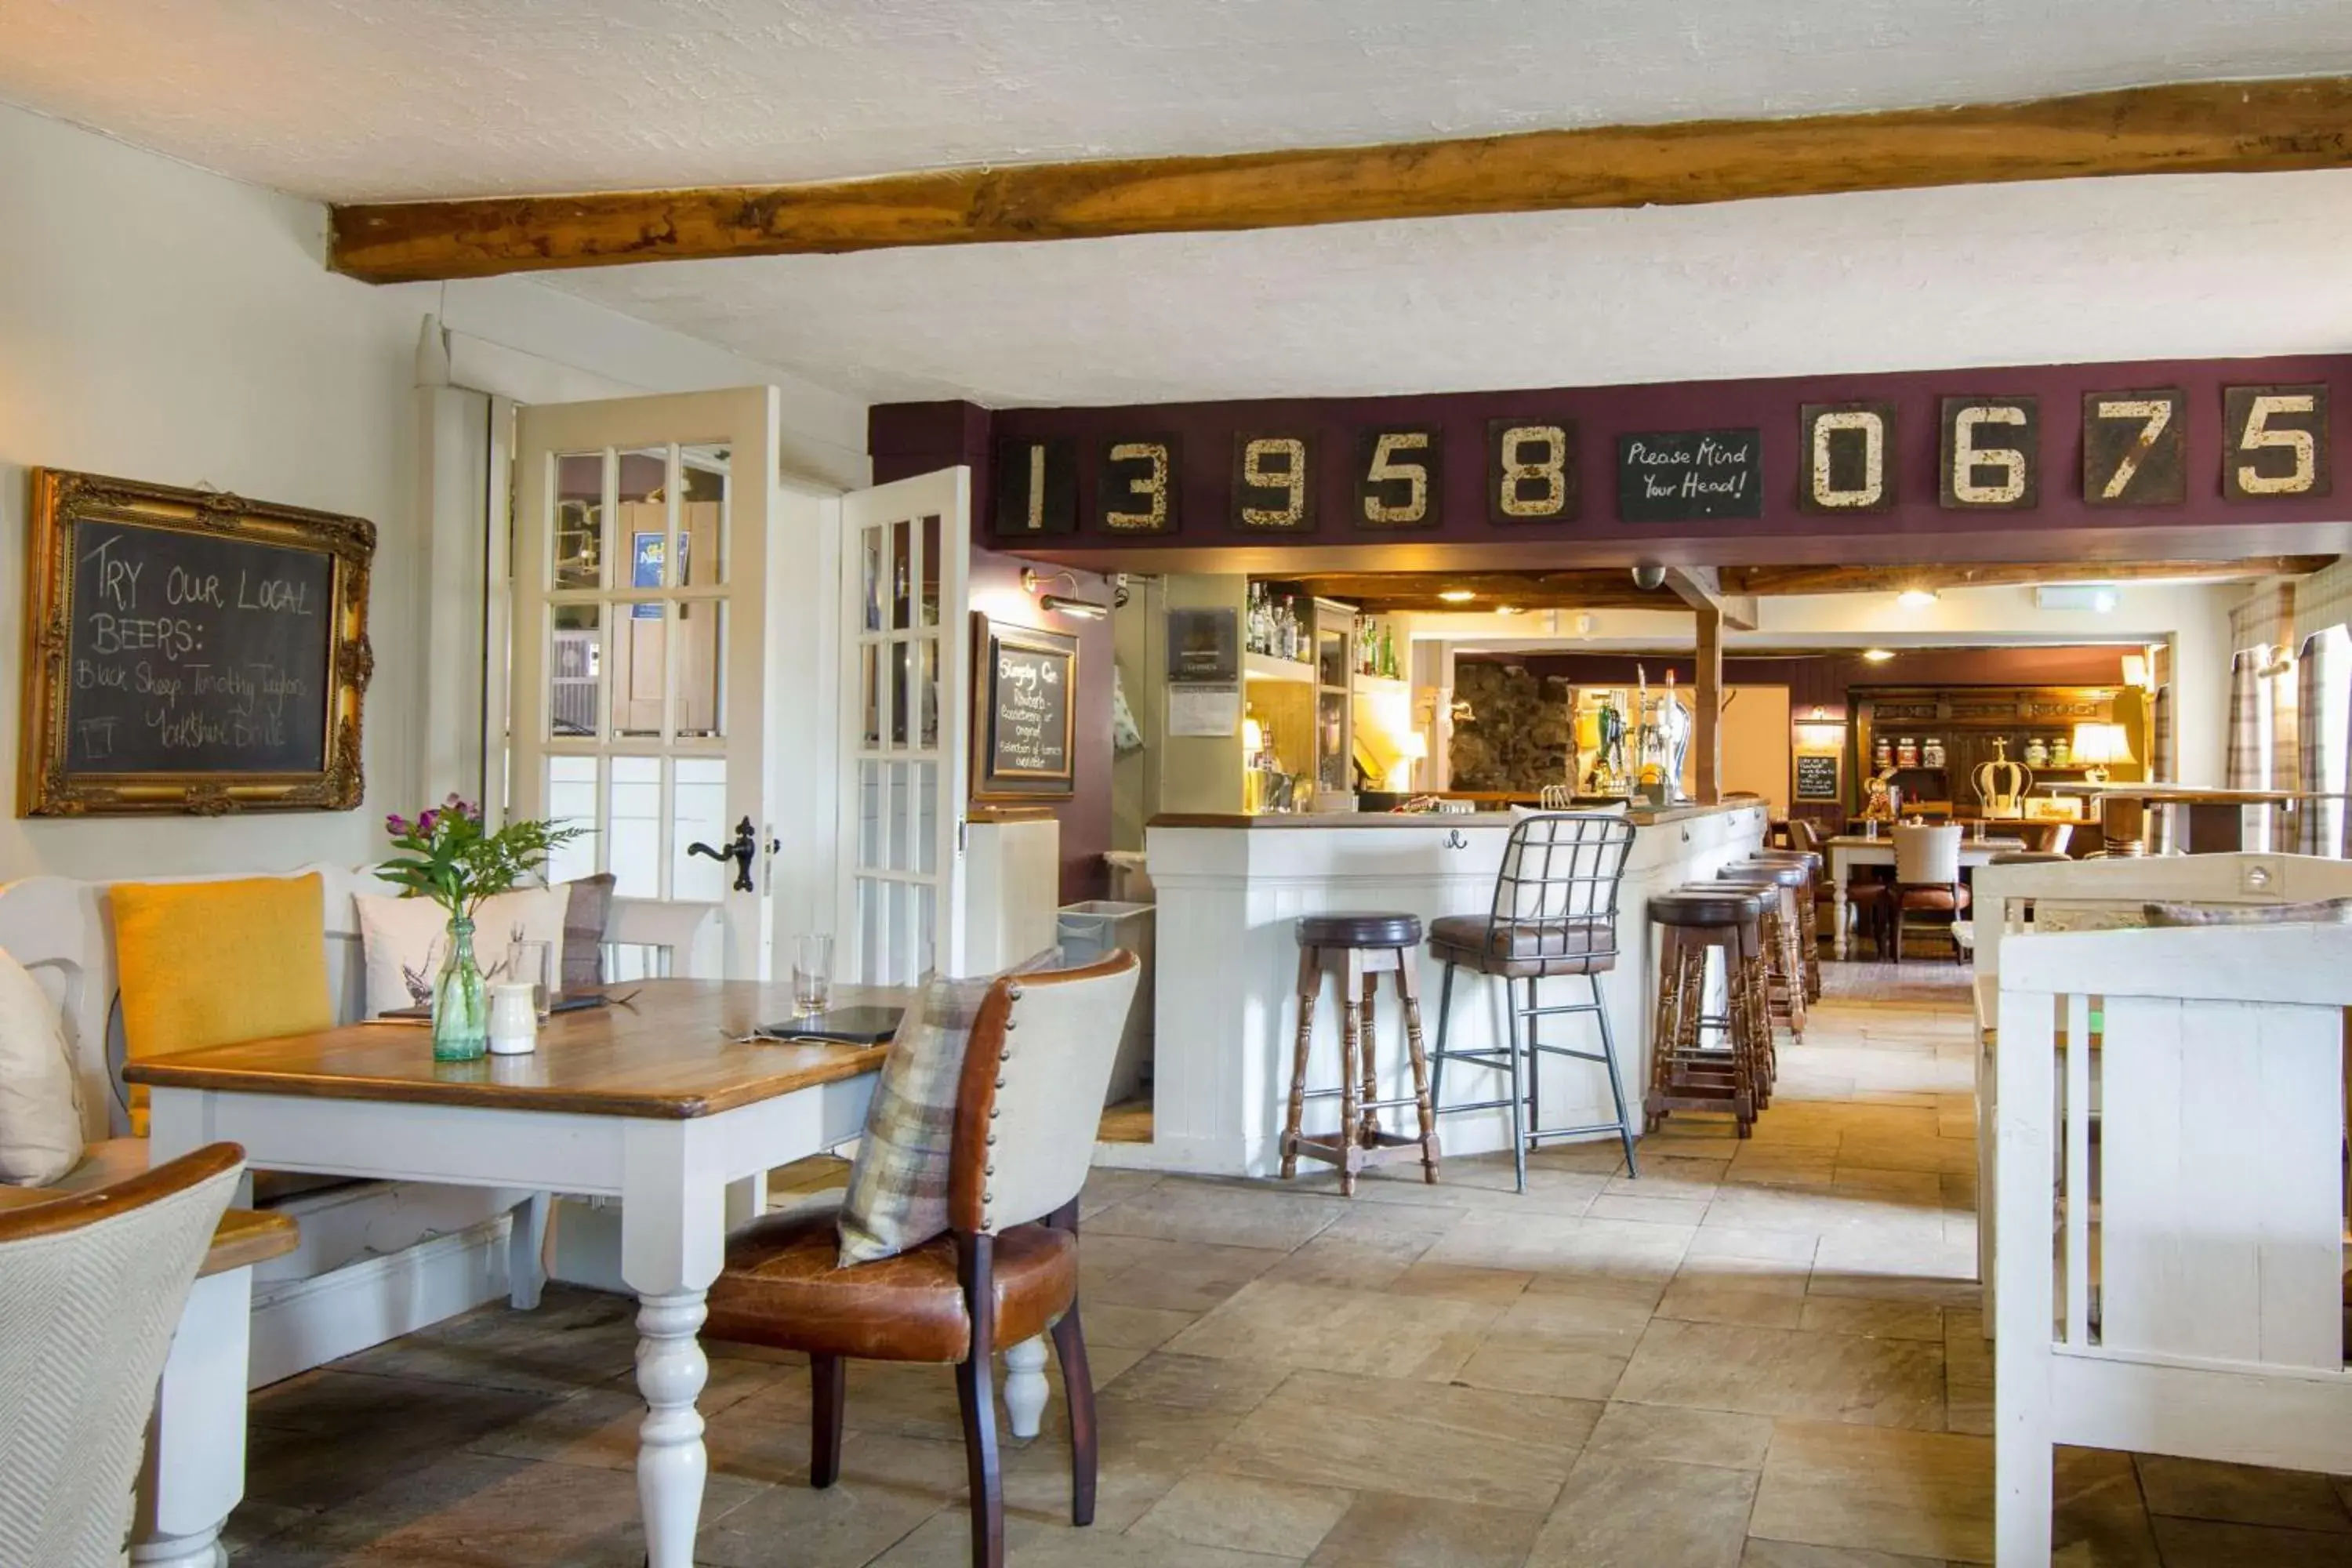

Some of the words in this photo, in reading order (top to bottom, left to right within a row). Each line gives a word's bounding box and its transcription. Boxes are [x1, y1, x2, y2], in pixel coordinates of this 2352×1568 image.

[1628, 441, 1690, 465] Please
[1696, 439, 1748, 466] Mind
[1813, 412, 1882, 508] 0
[1954, 406, 2027, 503] 6
[2099, 400, 2171, 499] 7
[2239, 395, 2314, 495] 5
[1028, 445, 1044, 529] 1
[1105, 443, 1168, 529] 3
[1242, 437, 1306, 527] 9
[1364, 433, 1429, 523] 5
[1501, 425, 1566, 517] 8
[1643, 474, 1677, 498] Your
[1681, 470, 1748, 499] Head!
[81, 535, 143, 612] TRY
[166, 565, 224, 609] OUR
[238, 568, 311, 615] LOCAL
[89, 612, 203, 662] BEERS:
[76, 659, 127, 691] Black
